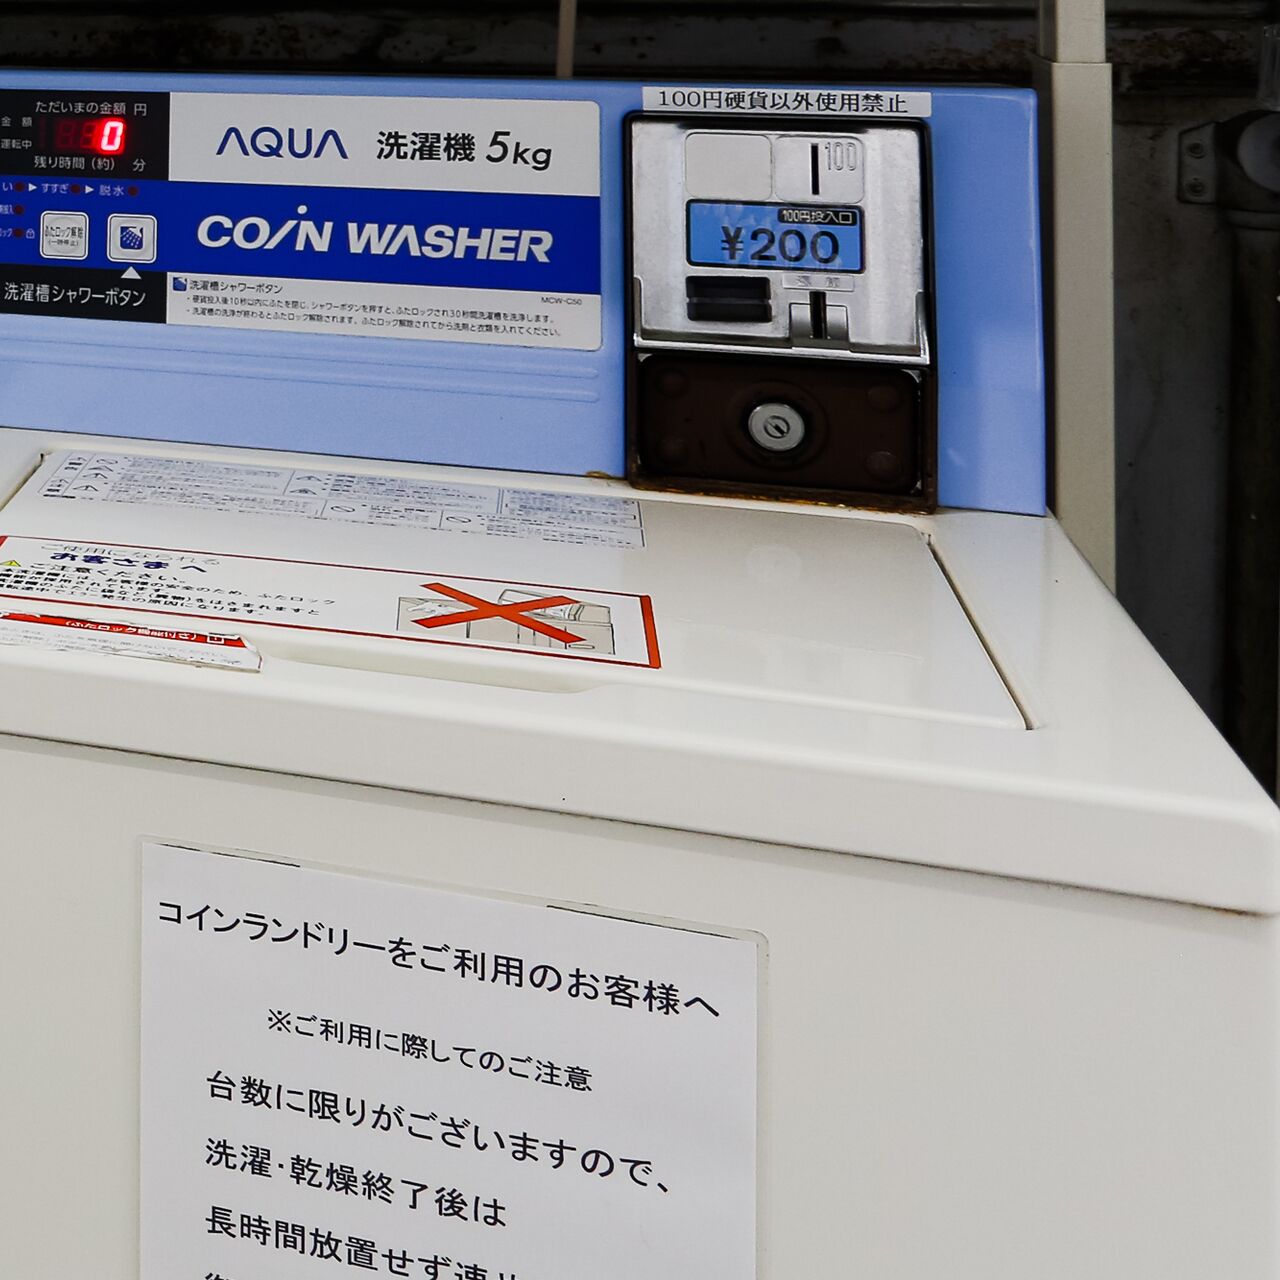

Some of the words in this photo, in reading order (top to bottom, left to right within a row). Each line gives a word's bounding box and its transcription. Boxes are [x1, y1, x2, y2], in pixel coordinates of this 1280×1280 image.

[35, 101, 127, 116] ただいまの金額
[133, 103, 147, 116] 円
[658, 90, 909, 115] 100円硬貨以外使用禁止
[0, 139, 32, 150] 運転中
[100, 121, 124, 151] 0
[216, 126, 349, 160] AQUA
[376, 130, 476, 163] 洗濯機
[485, 130, 553, 171] 5kg
[33, 155, 115, 171] 残り時間(約)
[132, 158, 146, 172] 分
[41, 183, 68, 194] すすぎ
[98, 184, 125, 196] 脱水
[781, 209, 853, 225] 100円投入口
[197, 204, 333, 253] COIN
[347, 221, 554, 263] WASHER
[720, 225, 840, 265] ¥200
[4, 281, 147, 307] 洗濯槽シャワーボタン
[189, 279, 284, 295] 洗濯槽シャワーボタン
[30, 562, 186, 584] ご注意ください。
[49, 551, 207, 573] お客さまへ
[158, 899, 722, 1019] コインランドリーをご利用のお客様へ
[266, 1007, 594, 1093] ※ご利用に際してのご注意
[206, 1069, 670, 1194] 台数に限りがございますので、
[205, 1137, 508, 1228] 洗濯・乾燥終了後は
